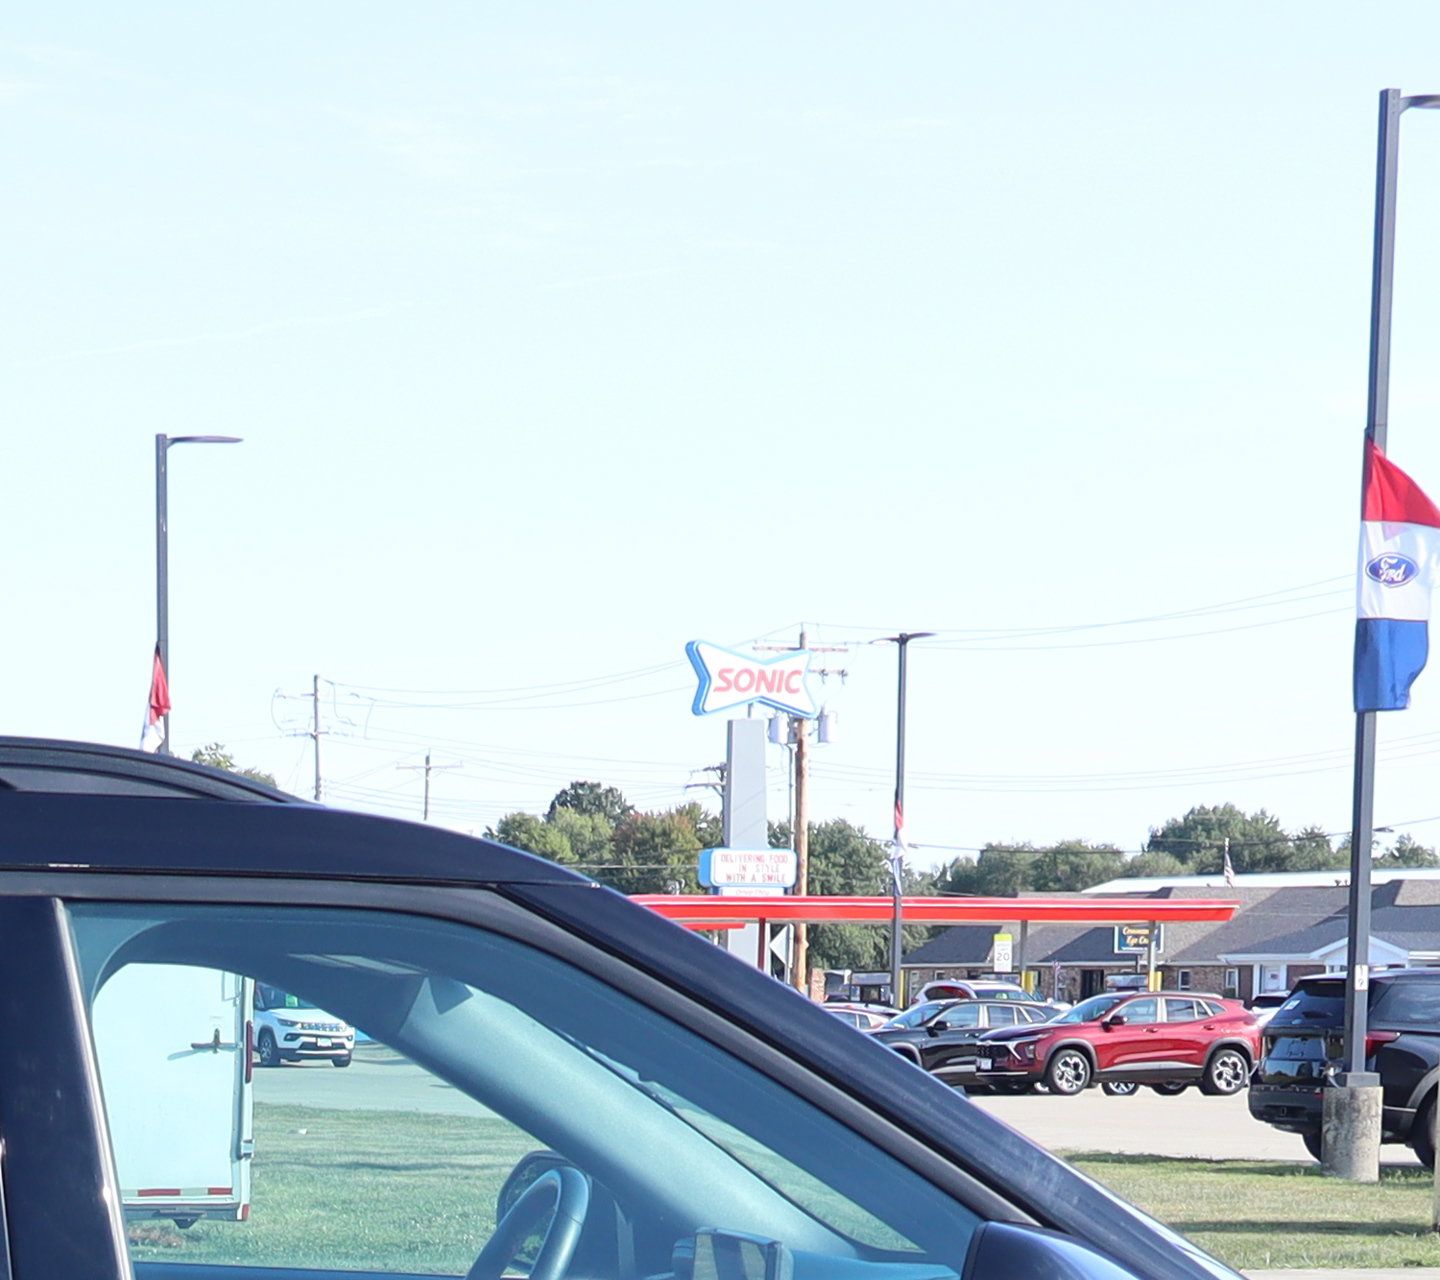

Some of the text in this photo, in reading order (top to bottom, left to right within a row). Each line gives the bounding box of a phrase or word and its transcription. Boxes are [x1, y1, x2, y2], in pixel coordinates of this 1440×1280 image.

[713, 668, 802, 694] SONIC
[721, 854, 788, 864] DELIVERING FOOD
[739, 864, 779, 873] IN STYLE
[726, 873, 786, 883] WITH A SMILE
[996, 952, 1010, 962] 20
